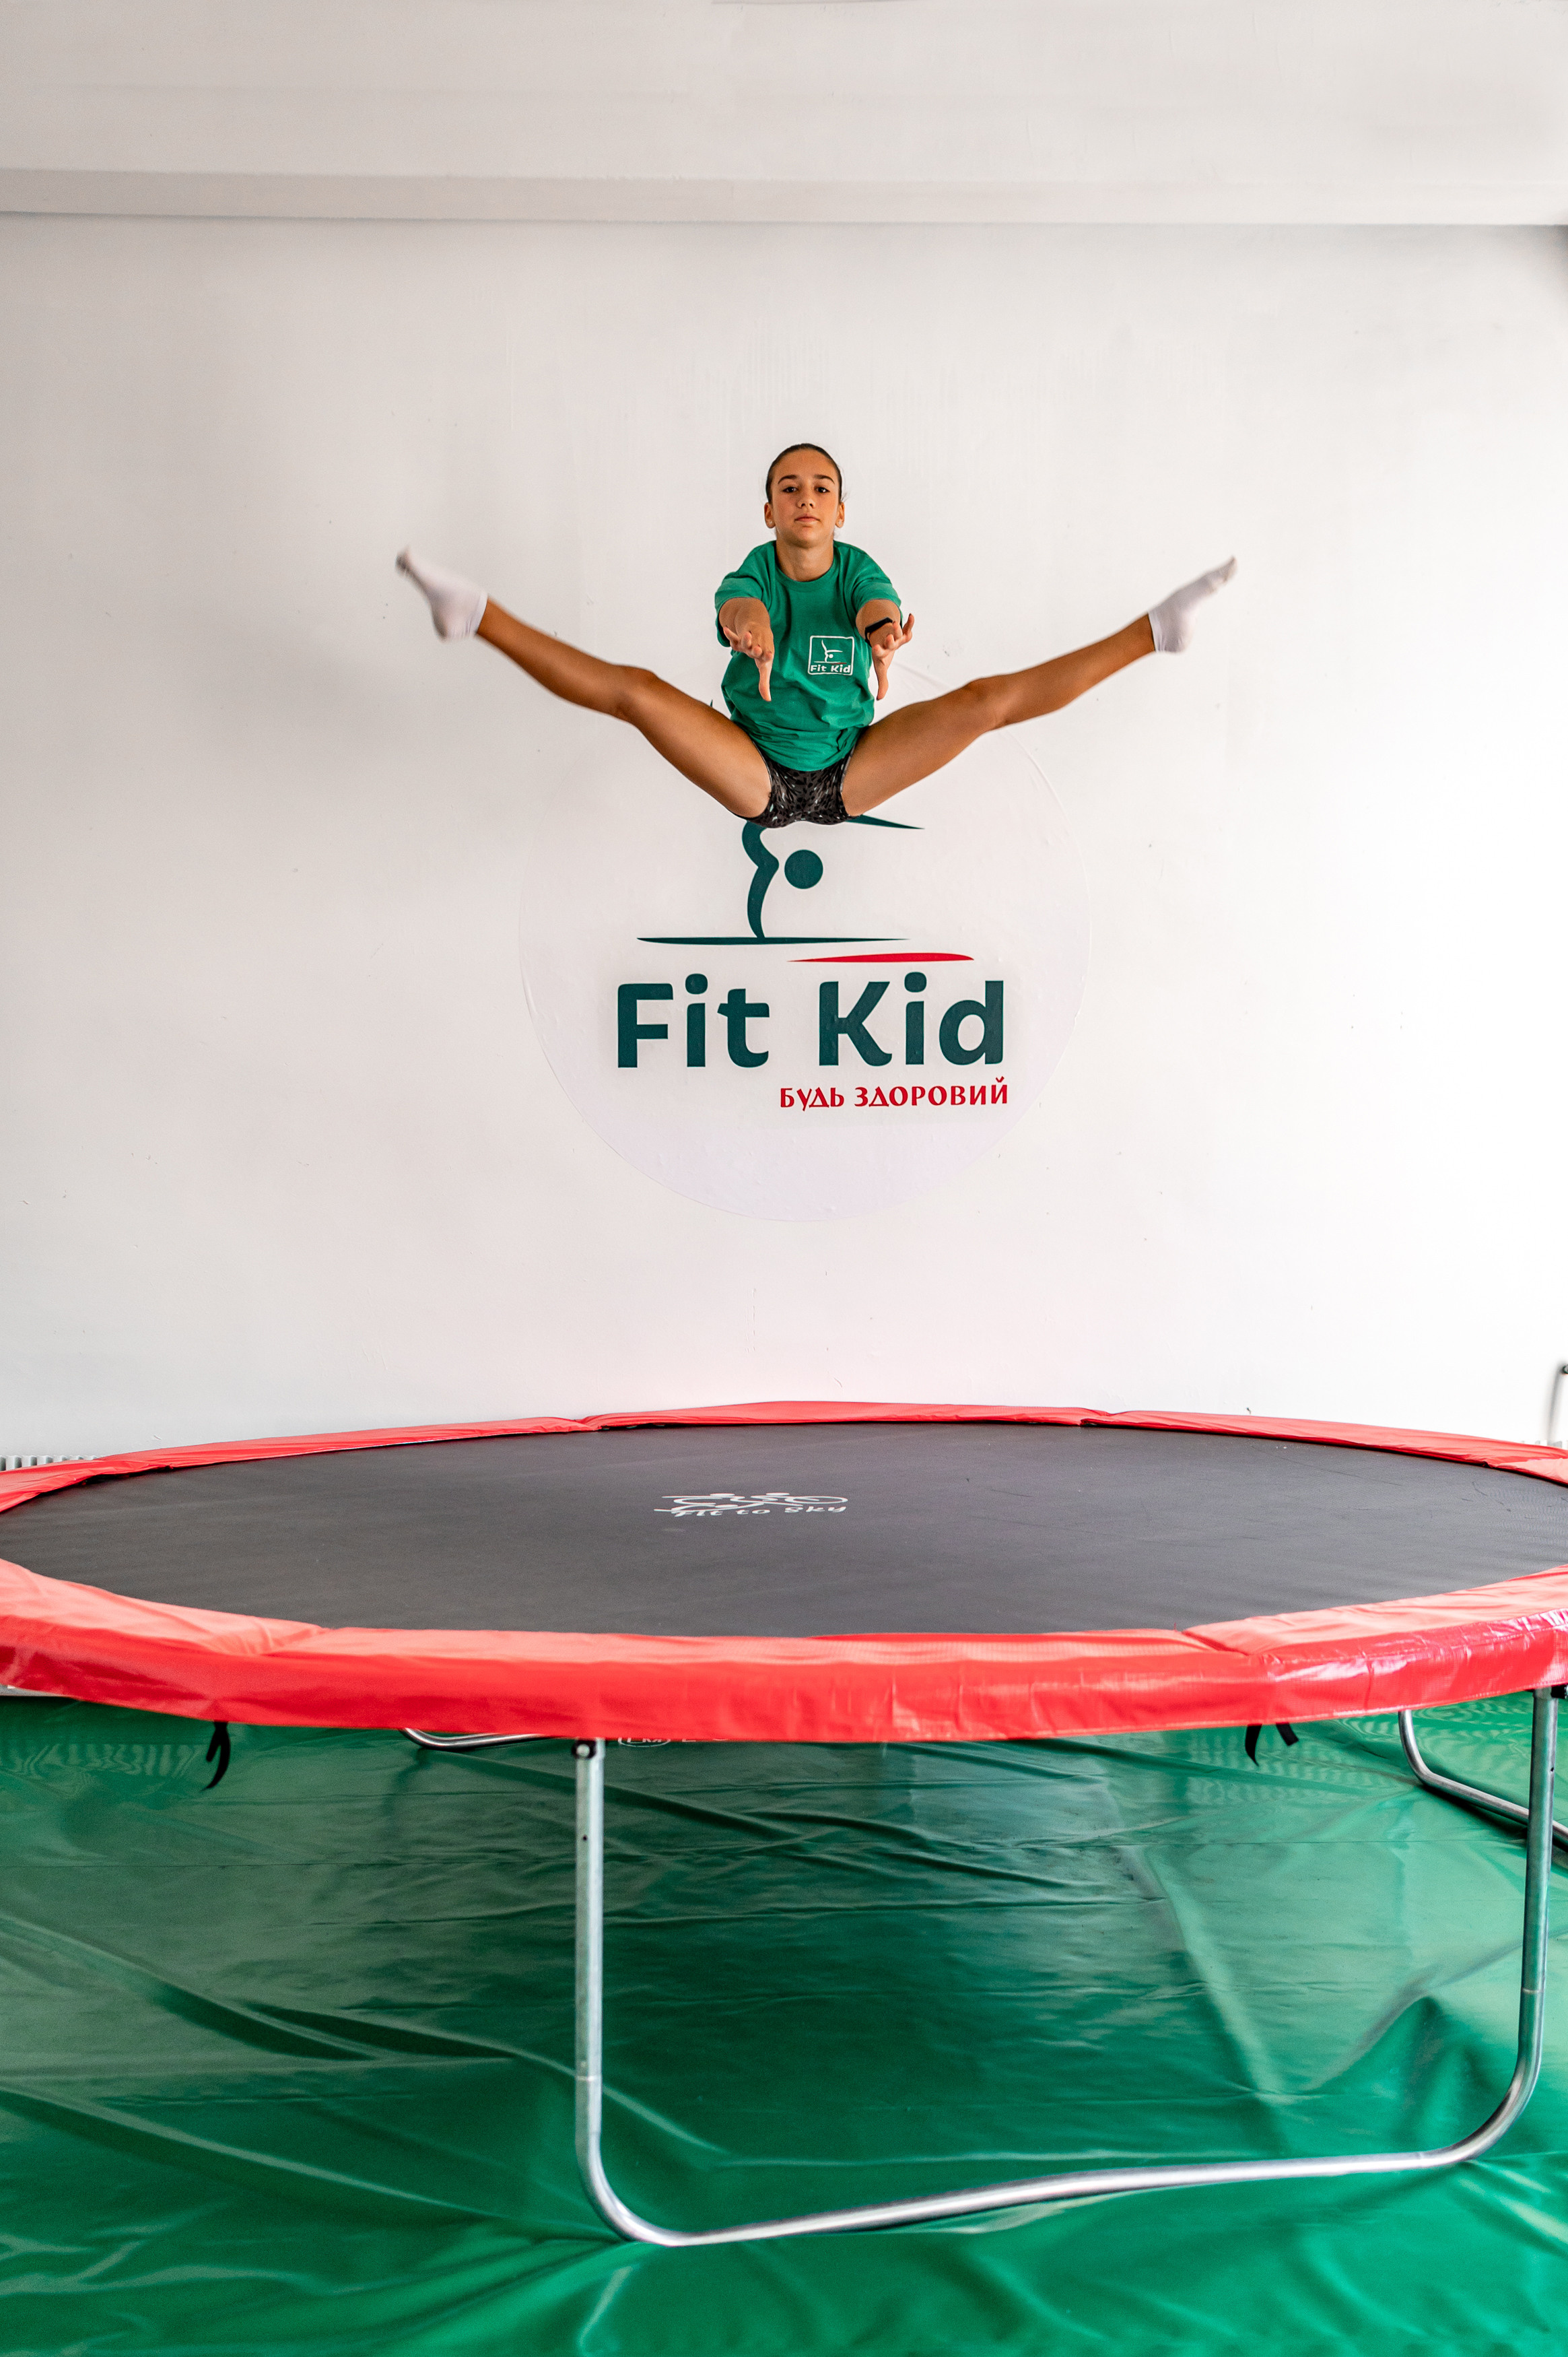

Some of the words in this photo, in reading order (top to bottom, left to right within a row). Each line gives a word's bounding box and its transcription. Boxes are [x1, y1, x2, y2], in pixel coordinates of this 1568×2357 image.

[830, 665, 851, 673] Kid
[617, 973, 770, 1068] Fit
[819, 972, 1004, 1066] Kid
[780, 1088, 844, 1111] БУДЬ
[855, 1076, 1008, 1107] ЗДОРОВИЙ
